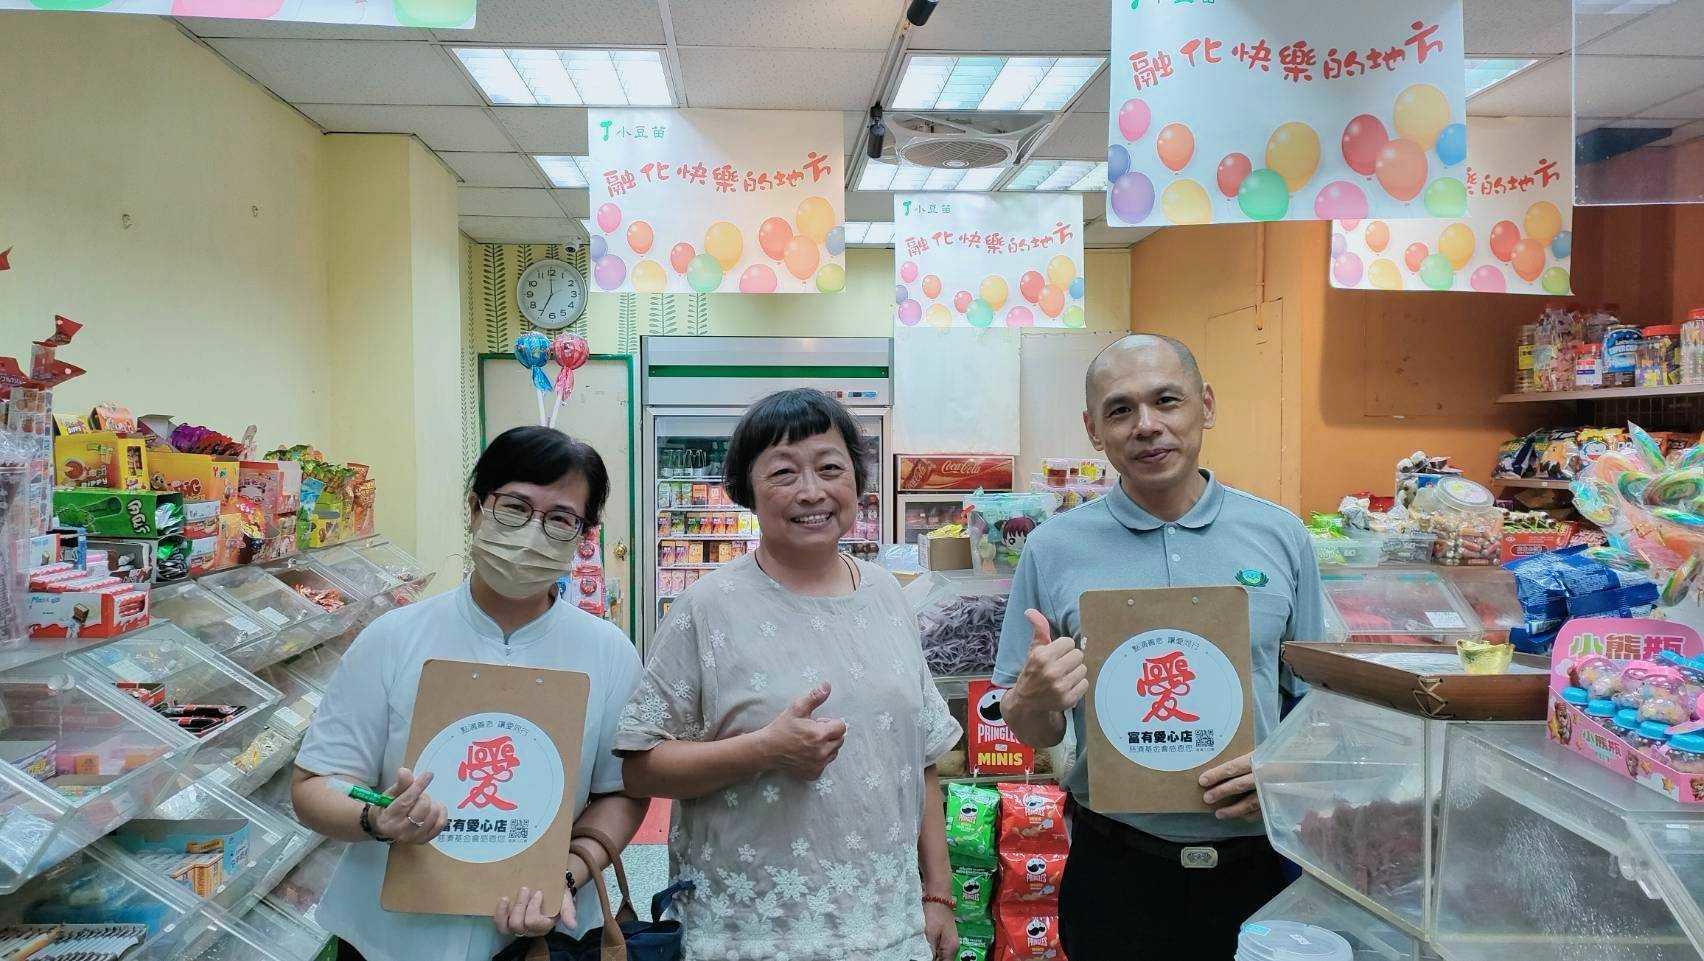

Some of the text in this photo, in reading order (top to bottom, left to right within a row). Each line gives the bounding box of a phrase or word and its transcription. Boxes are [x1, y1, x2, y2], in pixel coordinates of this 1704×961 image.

[1127, 20, 1444, 90] 融化快樂的地方
[616, 126, 666, 139] 小豆苗
[602, 151, 832, 198] 融化快樂的地方
[915, 204, 951, 214] 小豆苗
[904, 221, 1073, 257] 融化快樂的地方
[977, 722, 1021, 744] PRINGLE
[1128, 731, 1192, 743] 富有愛心店
[978, 752, 1023, 766] MINIS
